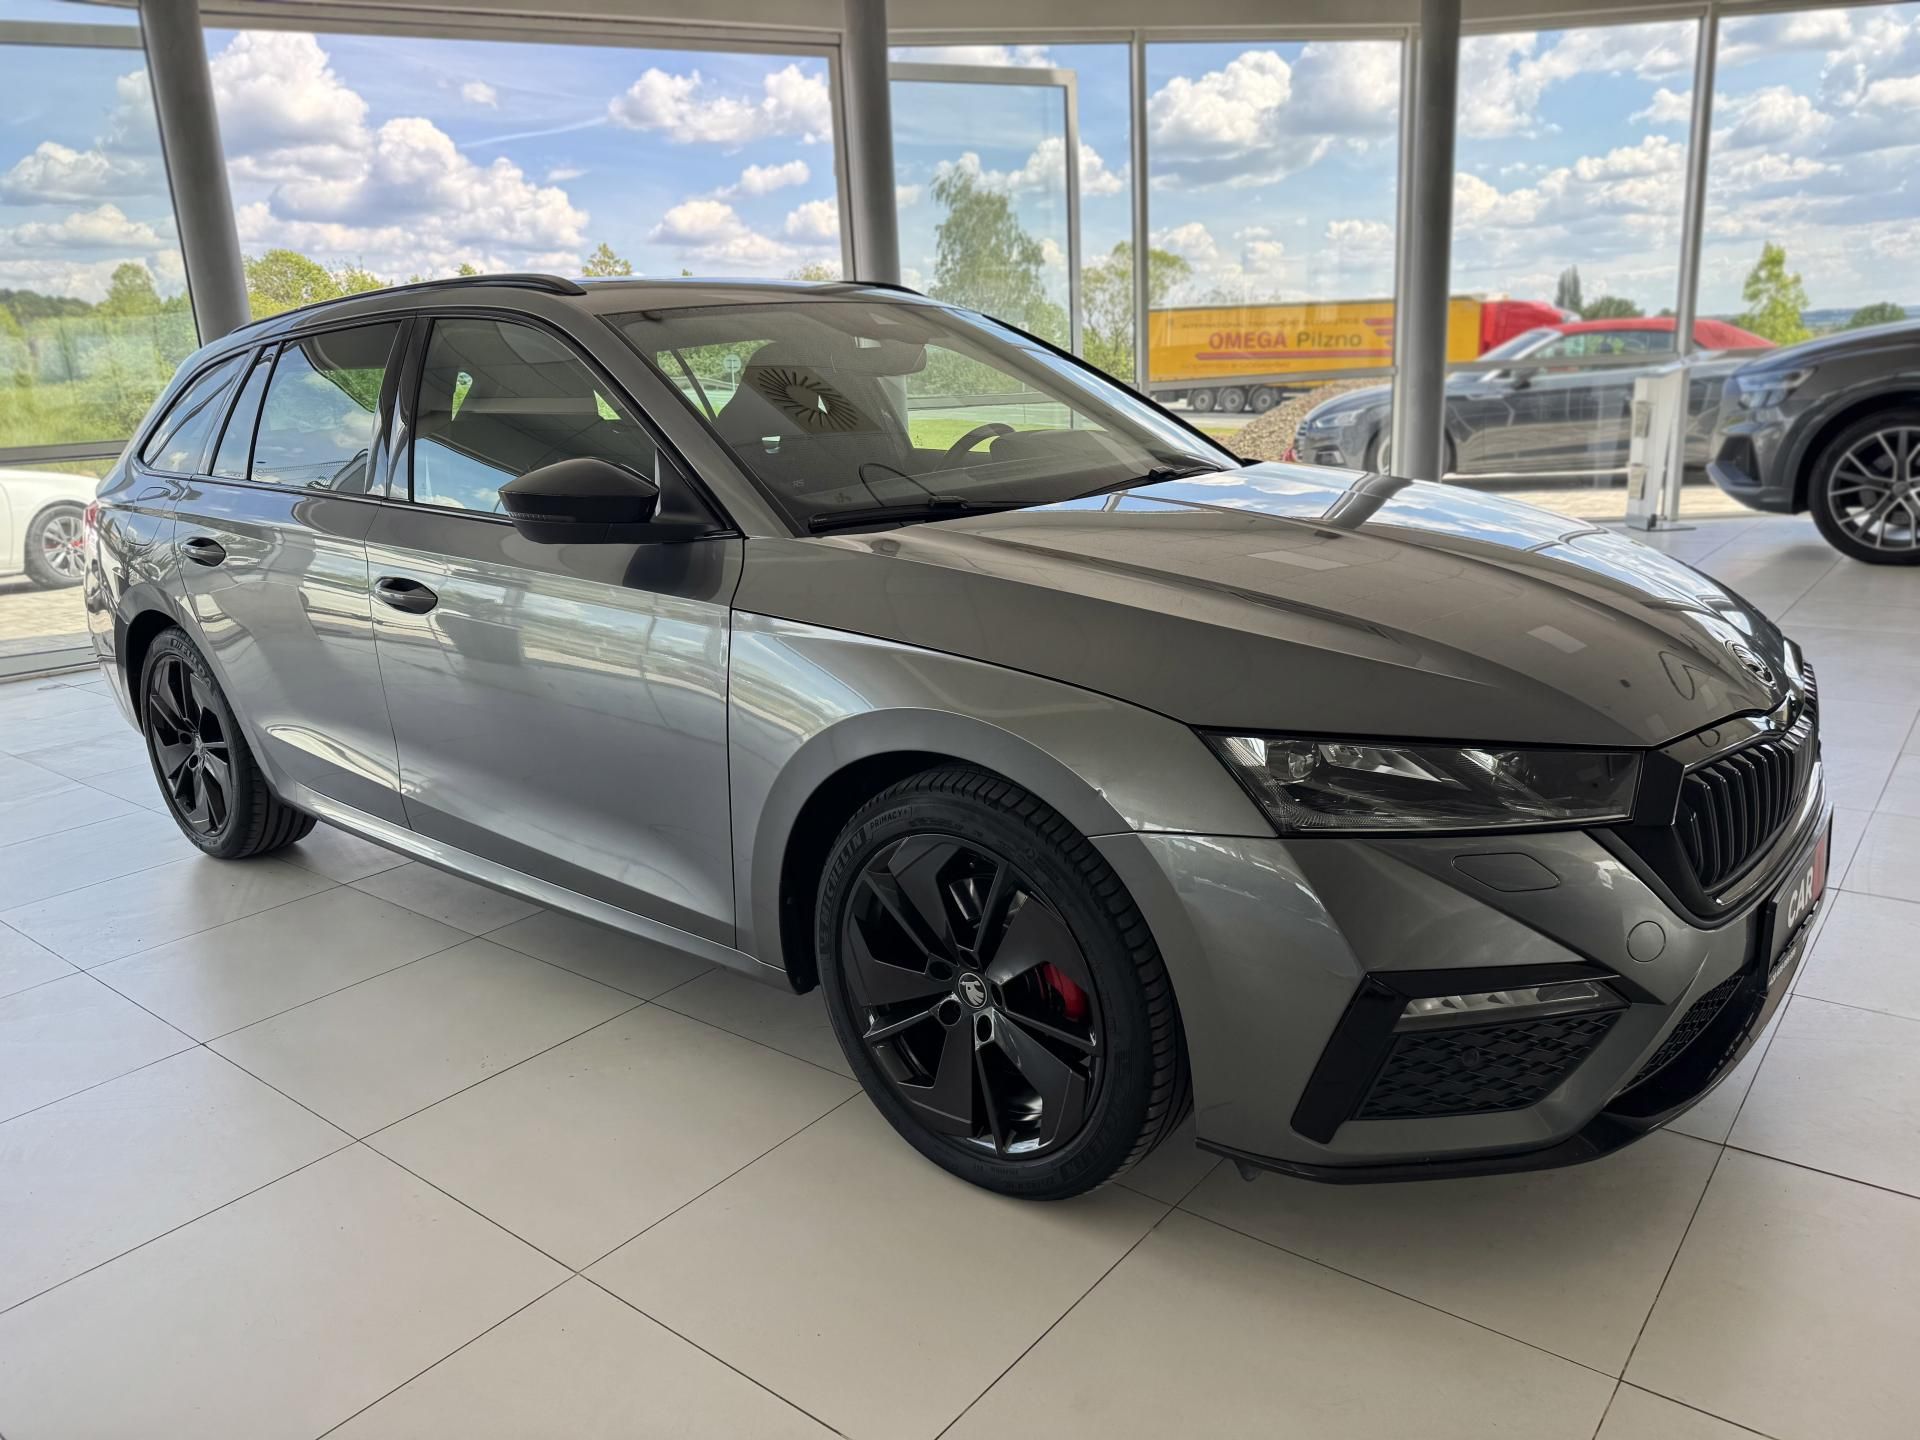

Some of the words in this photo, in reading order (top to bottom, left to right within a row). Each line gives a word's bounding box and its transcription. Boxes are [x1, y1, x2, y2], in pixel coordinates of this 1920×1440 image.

[1208, 330, 1288, 350] OMEGA
[1296, 331, 1363, 349] Pilzno
[819, 832, 863, 924] MICHELIN
[1787, 866, 1814, 928] CAR
